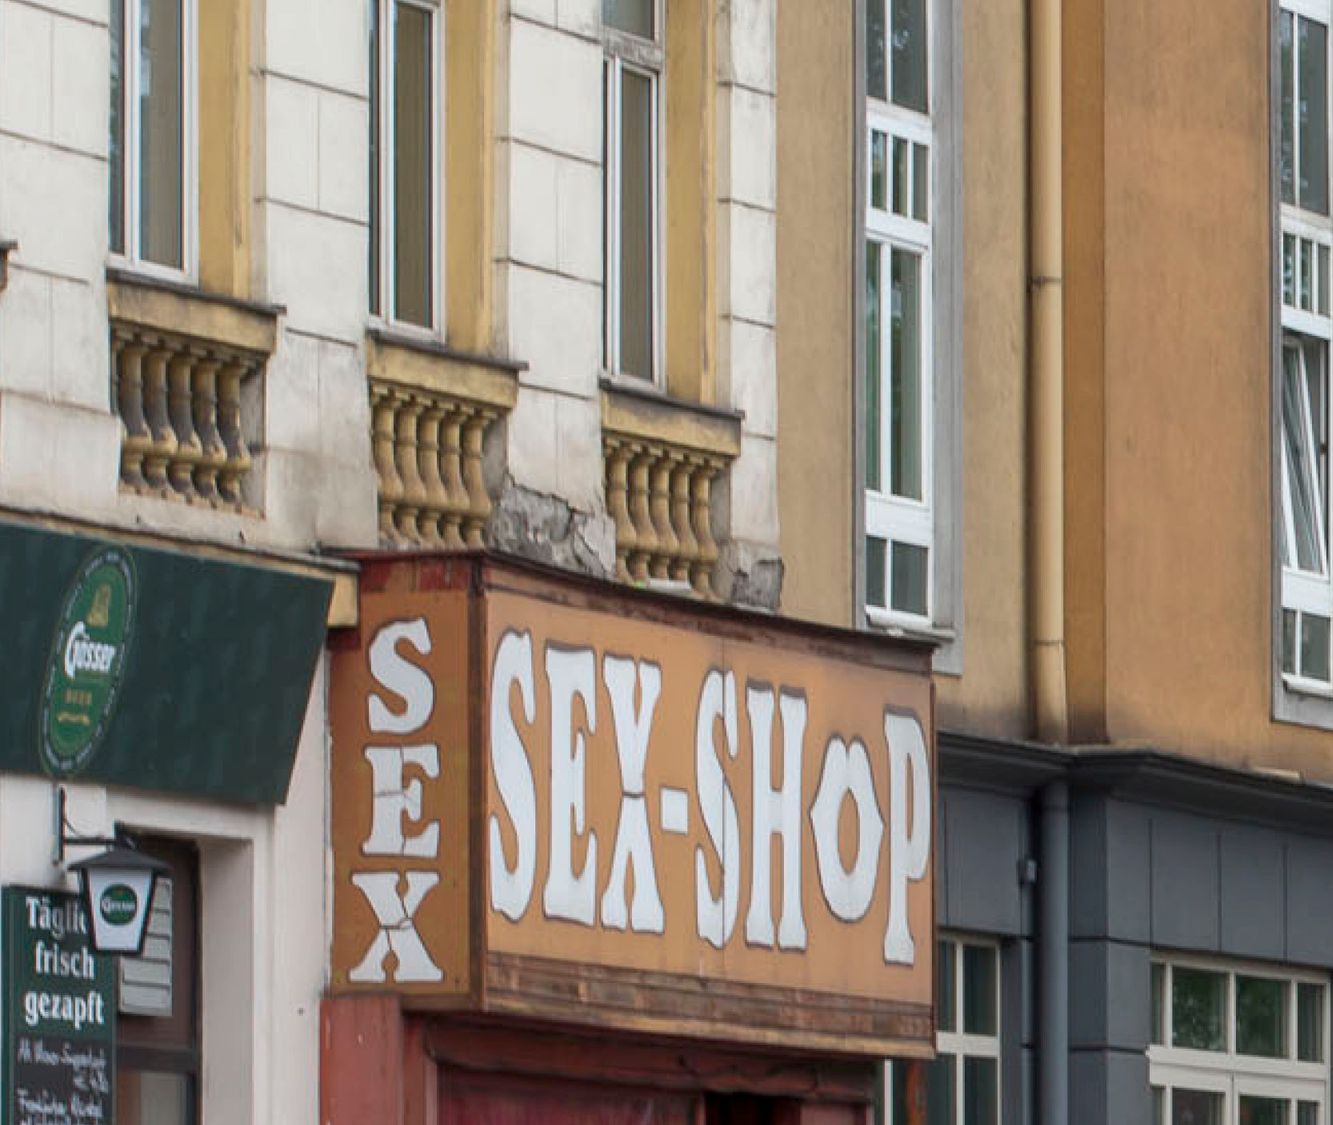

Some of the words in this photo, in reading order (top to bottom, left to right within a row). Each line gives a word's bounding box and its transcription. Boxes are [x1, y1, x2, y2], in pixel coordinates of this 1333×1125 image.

[348, 617, 444, 982] SEX
[488, 627, 931, 966] SEX-SHOP
[25, 990, 105, 1031] gezapft
[35, 939, 95, 980] frisch
